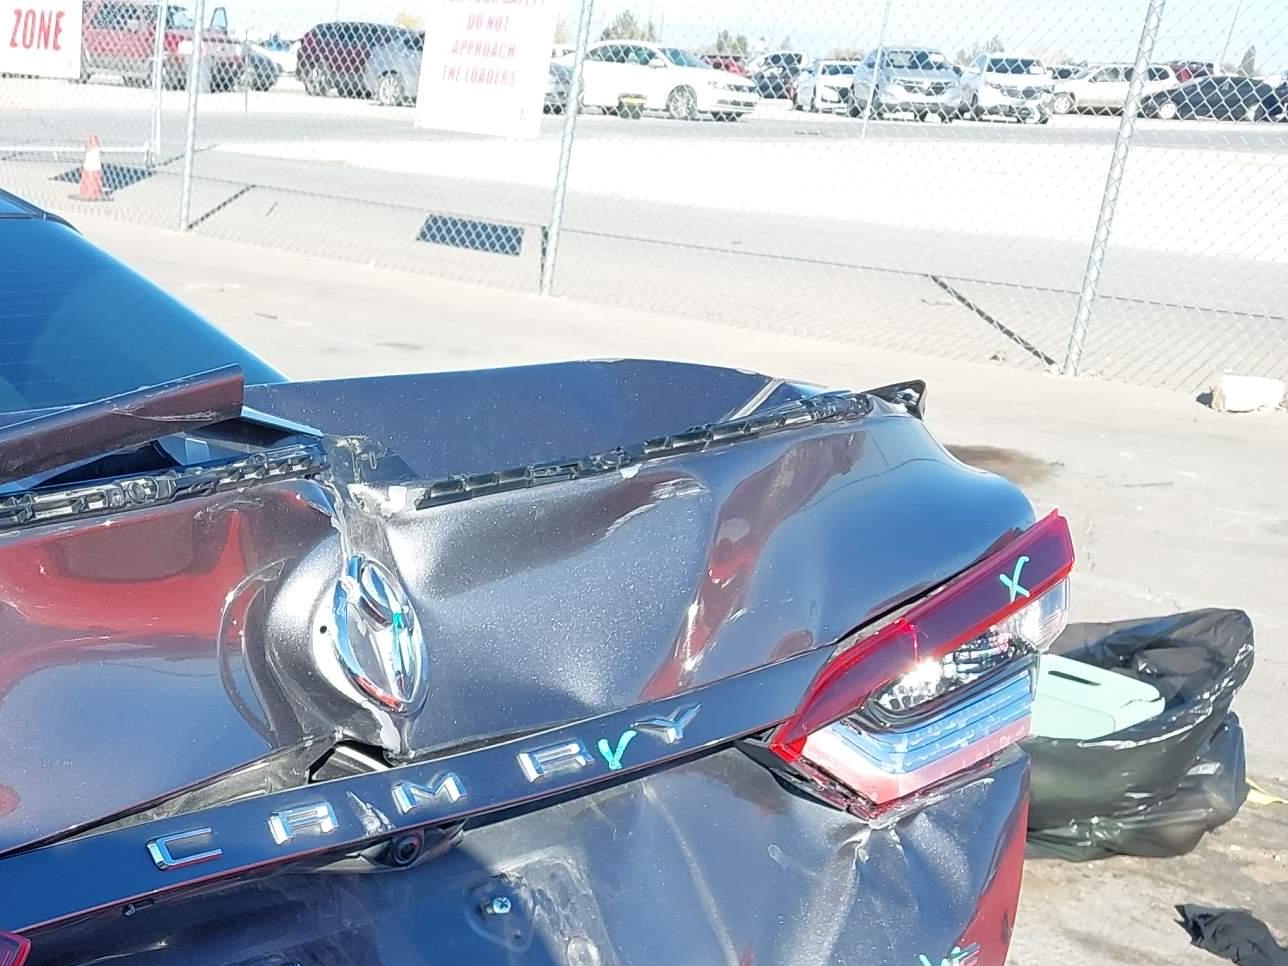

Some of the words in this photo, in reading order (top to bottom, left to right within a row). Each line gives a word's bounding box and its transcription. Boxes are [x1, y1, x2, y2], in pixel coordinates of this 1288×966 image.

[10, 8, 65, 50] ZONE
[467, 15, 483, 30] DO
[487, 15, 510, 32] NOT
[452, 41, 516, 59] APPROACH
[442, 65, 461, 82] THE
[465, 67, 517, 86] LOADERS
[146, 703, 702, 872] CAMRY
